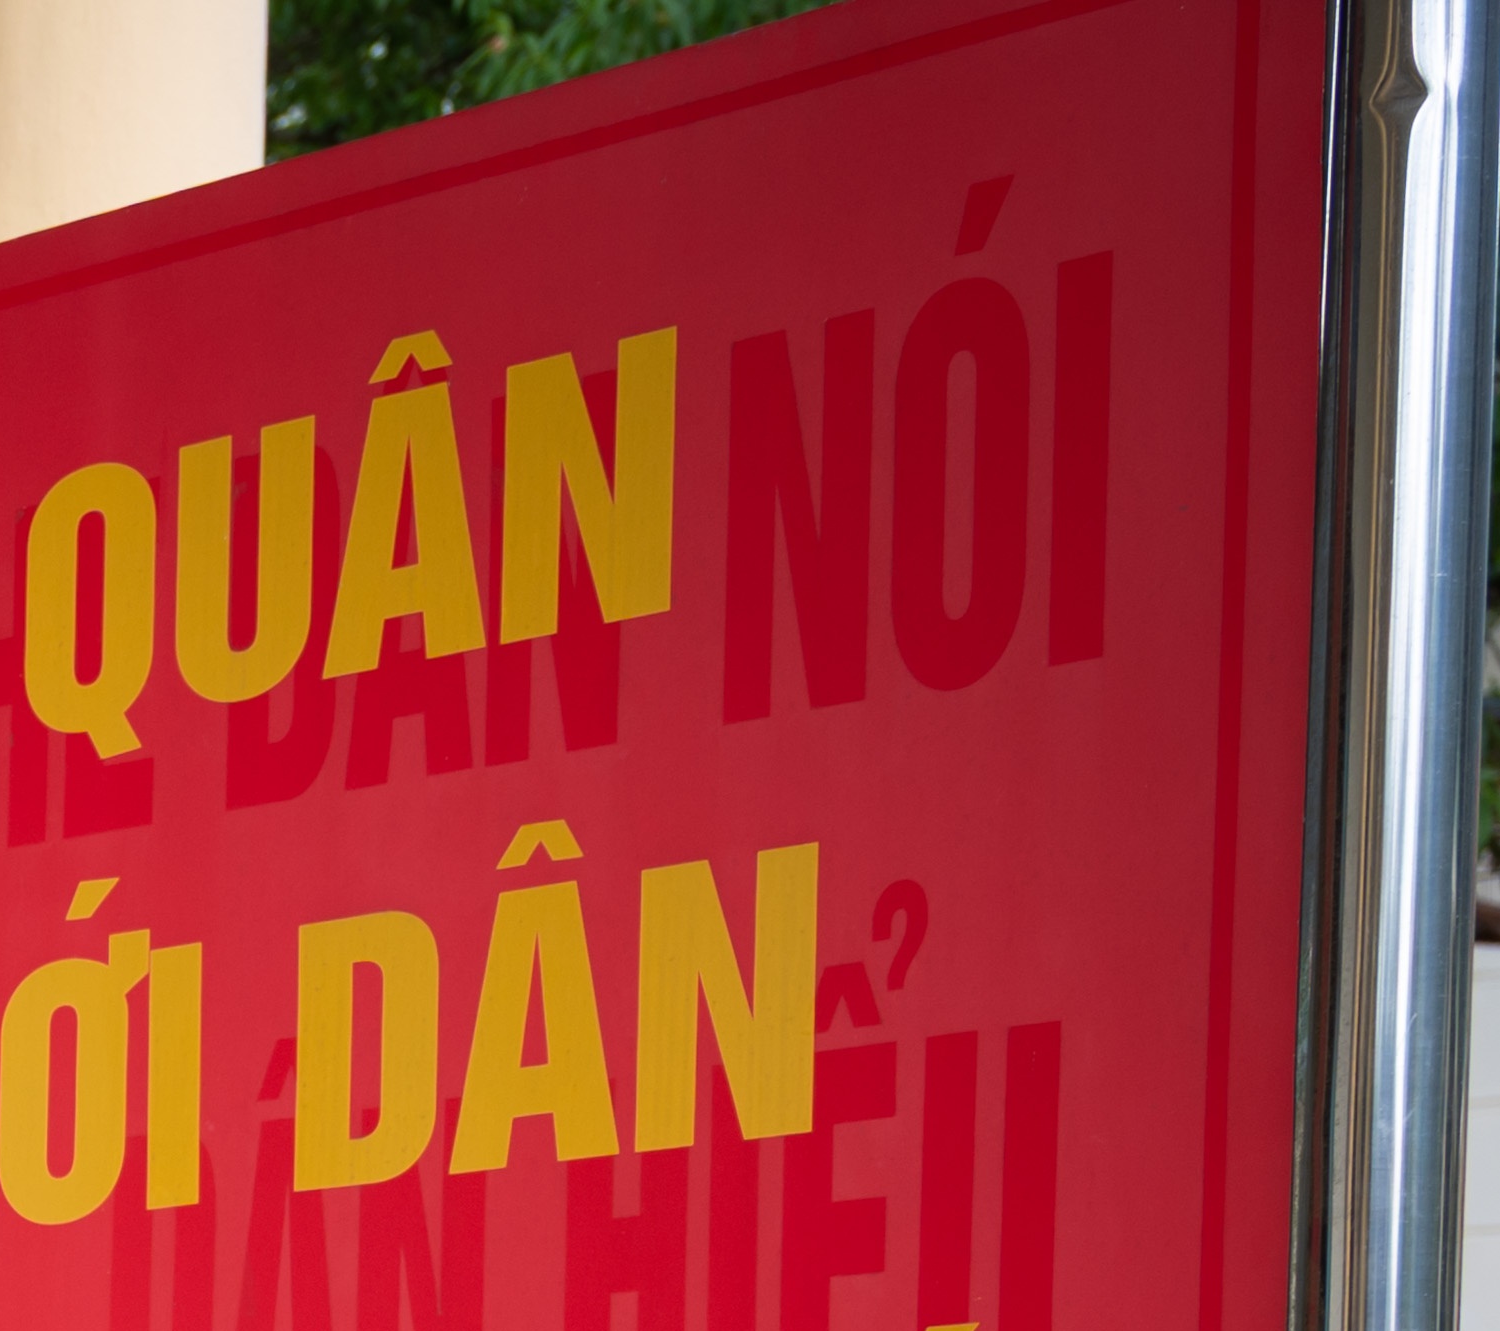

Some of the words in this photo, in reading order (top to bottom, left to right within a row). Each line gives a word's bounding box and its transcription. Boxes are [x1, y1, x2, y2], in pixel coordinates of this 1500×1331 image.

[25, 328, 676, 759] QUÂN
[724, 174, 1114, 725] NÓI
[295, 821, 818, 1191] DÂN
